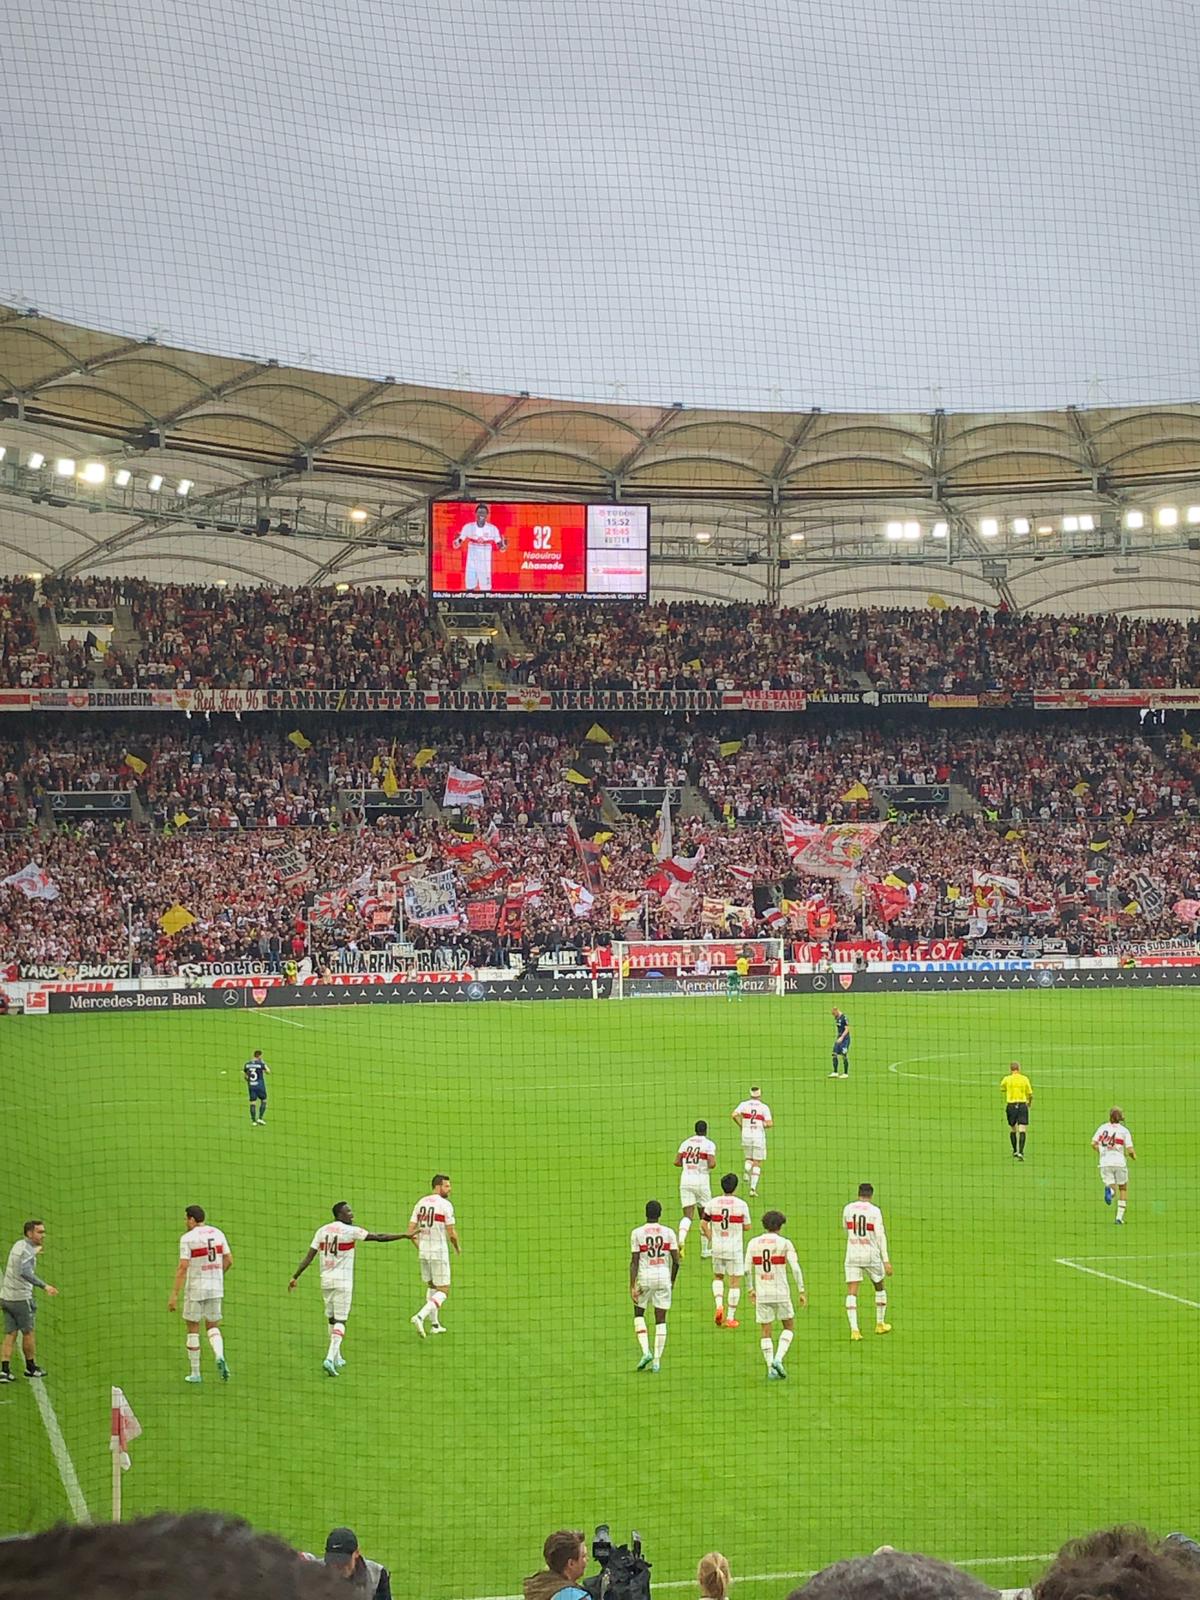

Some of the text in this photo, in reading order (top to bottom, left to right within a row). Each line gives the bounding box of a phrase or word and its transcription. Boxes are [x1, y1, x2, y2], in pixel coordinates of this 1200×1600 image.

[533, 526, 552, 549] 32
[521, 561, 565, 570] Ahamada
[88, 692, 153, 706] BERKHEIM
[194, 688, 216, 710] Red
[438, 691, 507, 709] KURVE
[551, 691, 723, 709] NECKARSTADION
[882, 693, 929, 703] STUTTGART
[19, 964, 129, 979] YARD BWOYS
[70, 991, 206, 1009] Mercedes-Benz Bank
[250, 1068, 258, 1081] 3
[750, 1110, 757, 1124] 2
[1102, 1130, 1115, 1147] 24
[685, 1147, 700, 1164] 23
[419, 1206, 435, 1227] 20
[721, 1209, 729, 1230] 3
[853, 1215, 866, 1237] 10
[208, 1238, 216, 1262] 5
[325, 1234, 338, 1256] 14
[646, 1236, 665, 1258] 32
[763, 1249, 771, 1273] 8
